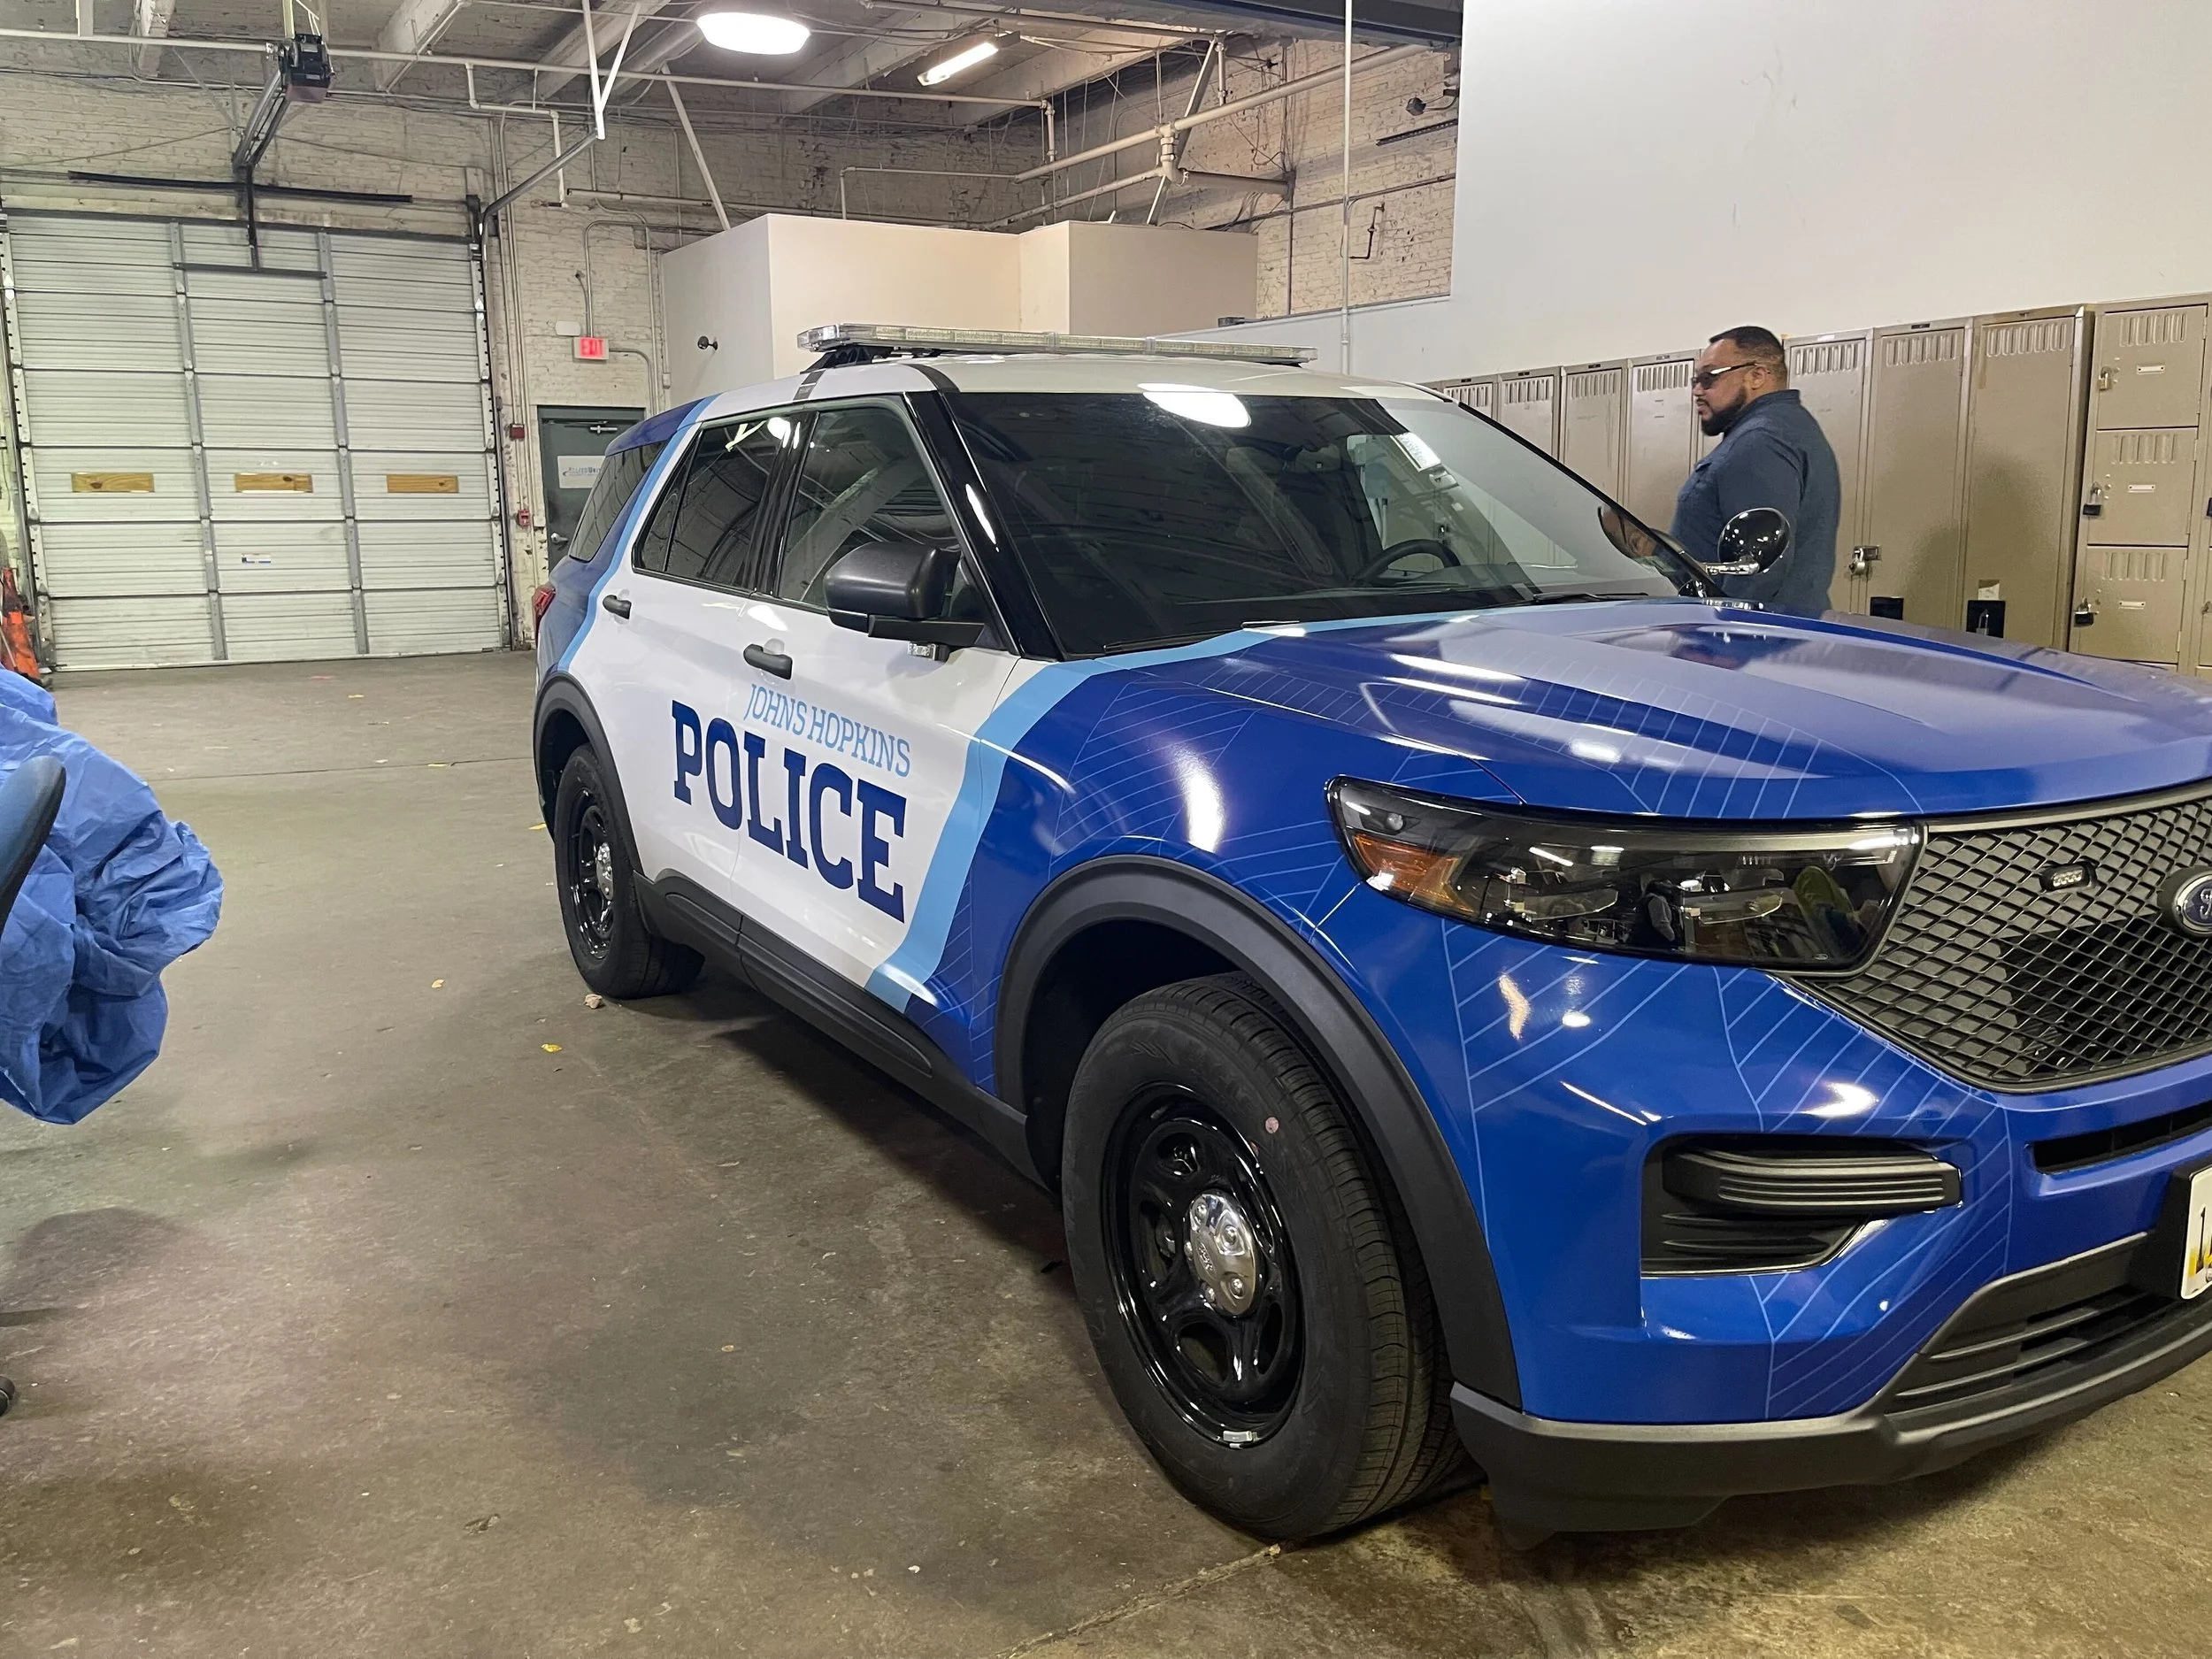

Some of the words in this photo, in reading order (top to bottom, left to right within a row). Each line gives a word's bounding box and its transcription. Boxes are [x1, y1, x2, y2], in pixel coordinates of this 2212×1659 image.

[581, 338, 603, 356] EXIT
[743, 684, 807, 735] JOHNS
[807, 705, 910, 778] HOPKINS
[672, 700, 907, 924] POLICE
